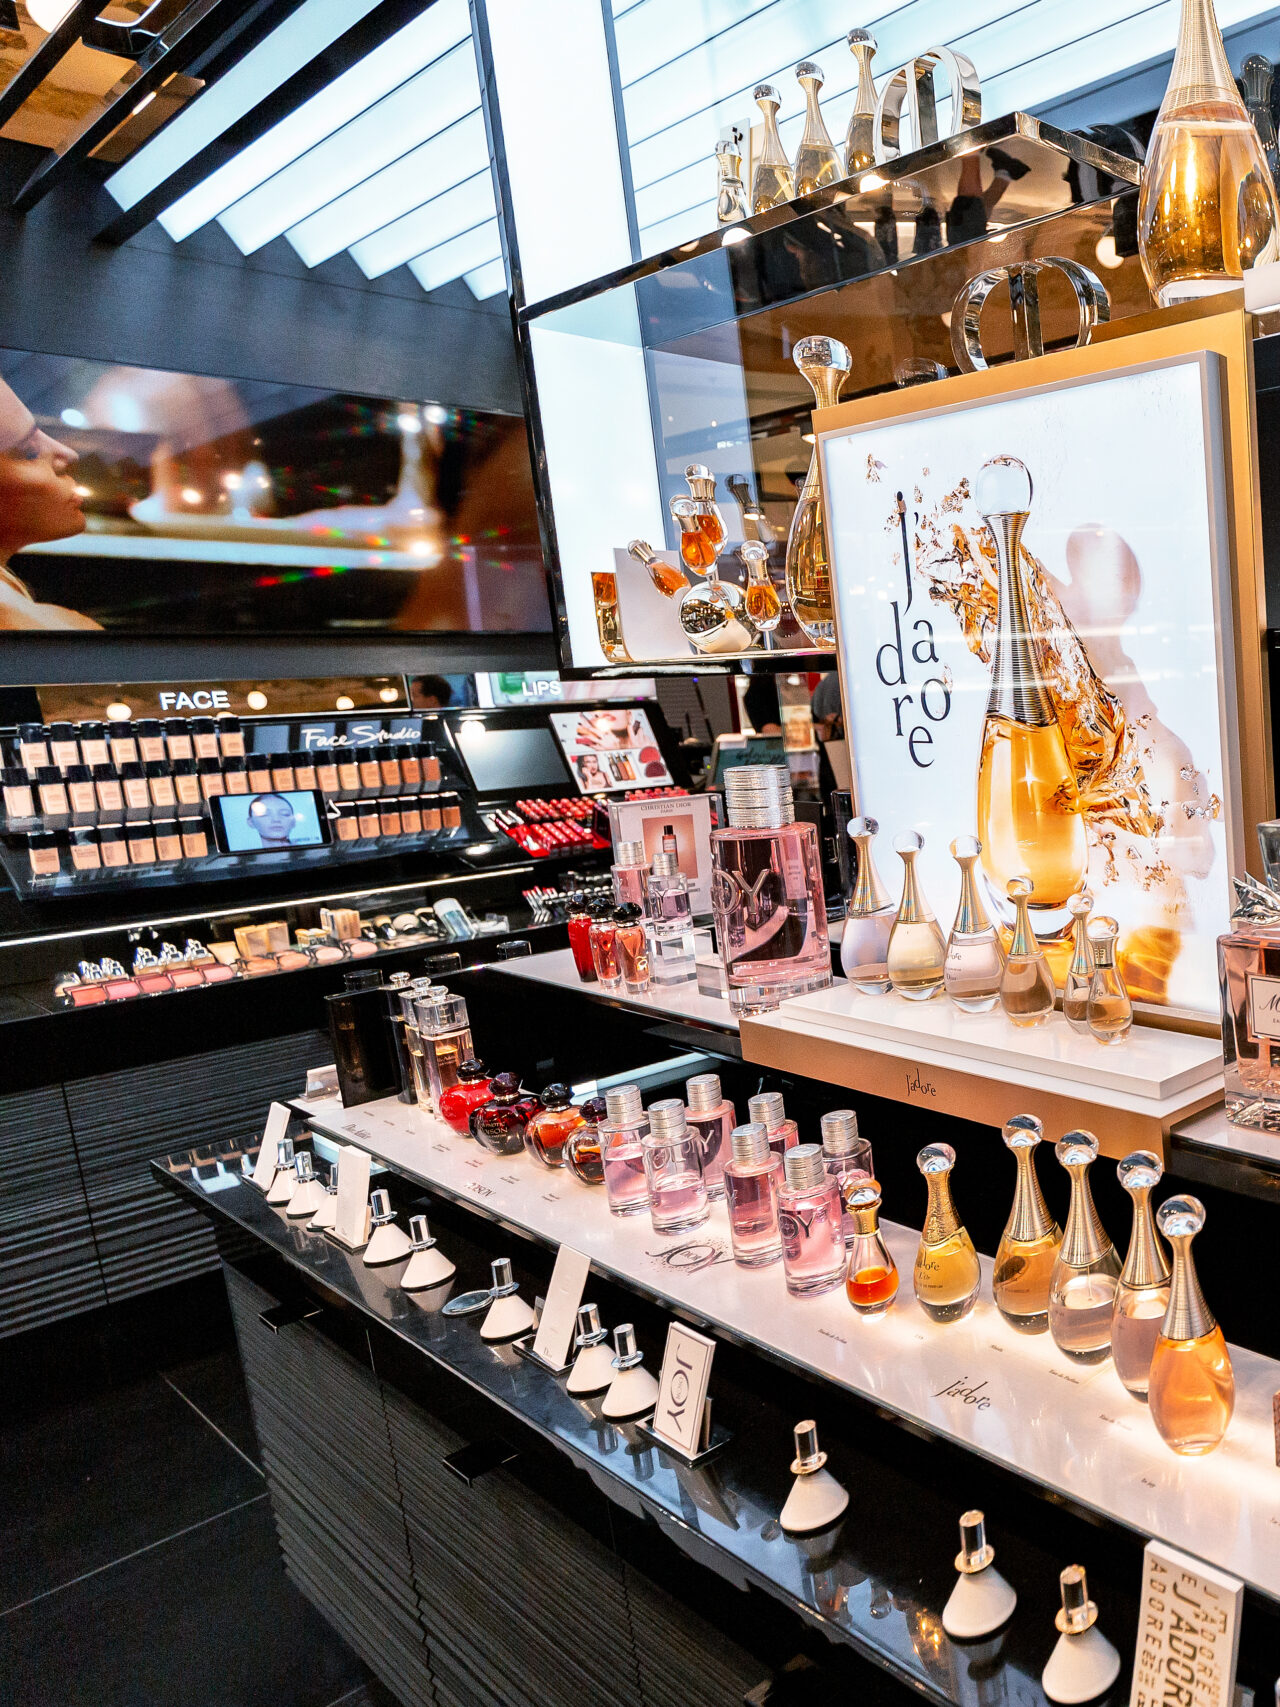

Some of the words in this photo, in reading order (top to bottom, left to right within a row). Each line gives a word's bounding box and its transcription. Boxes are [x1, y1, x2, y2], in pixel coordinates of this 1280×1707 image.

[522, 680, 562, 697] LIPS
[159, 690, 231, 711] FACE
[301, 728, 356, 749] Face
[351, 725, 421, 744] Studio
[641, 803, 675, 811] CHRISTIAN
[667, 1343, 693, 1433] JOY
[1163, 1582, 1203, 1707] J'ADOR
